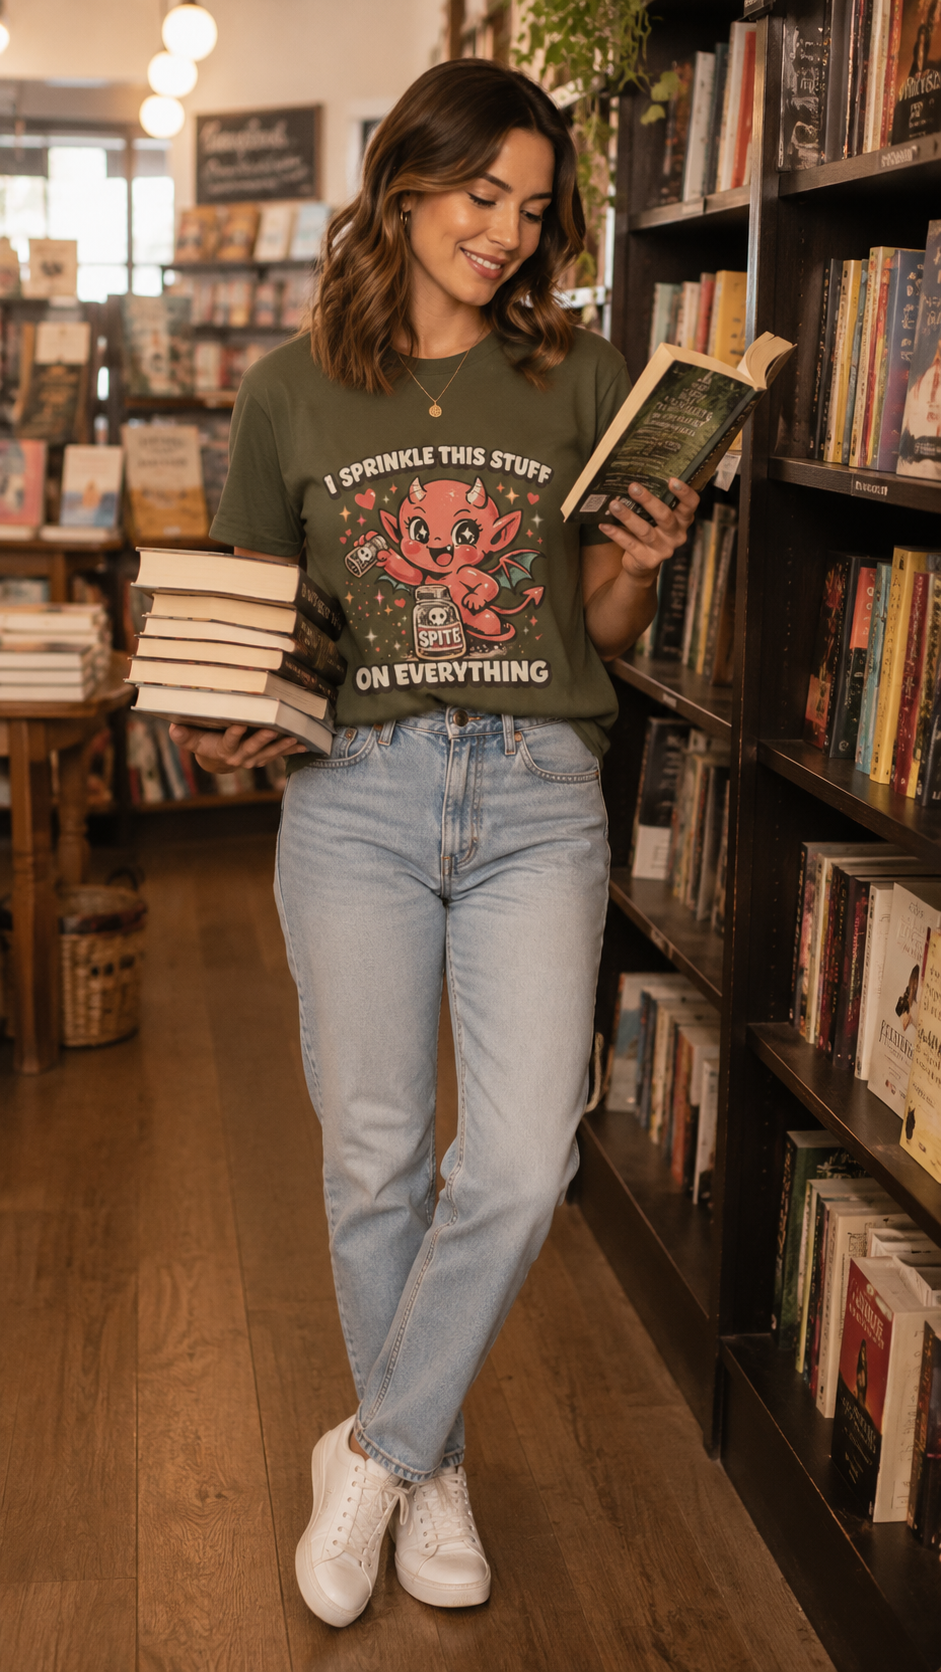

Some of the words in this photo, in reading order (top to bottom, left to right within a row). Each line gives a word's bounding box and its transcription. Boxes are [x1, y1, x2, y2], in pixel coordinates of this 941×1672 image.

[324, 475, 338, 494] I
[339, 446, 435, 488] SPRINKLE
[438, 446, 486, 465] THIS
[490, 451, 552, 483] STUFF
[418, 627, 462, 648] SPITE
[356, 666, 390, 690] ON
[394, 660, 549, 685] EVERYTHING
